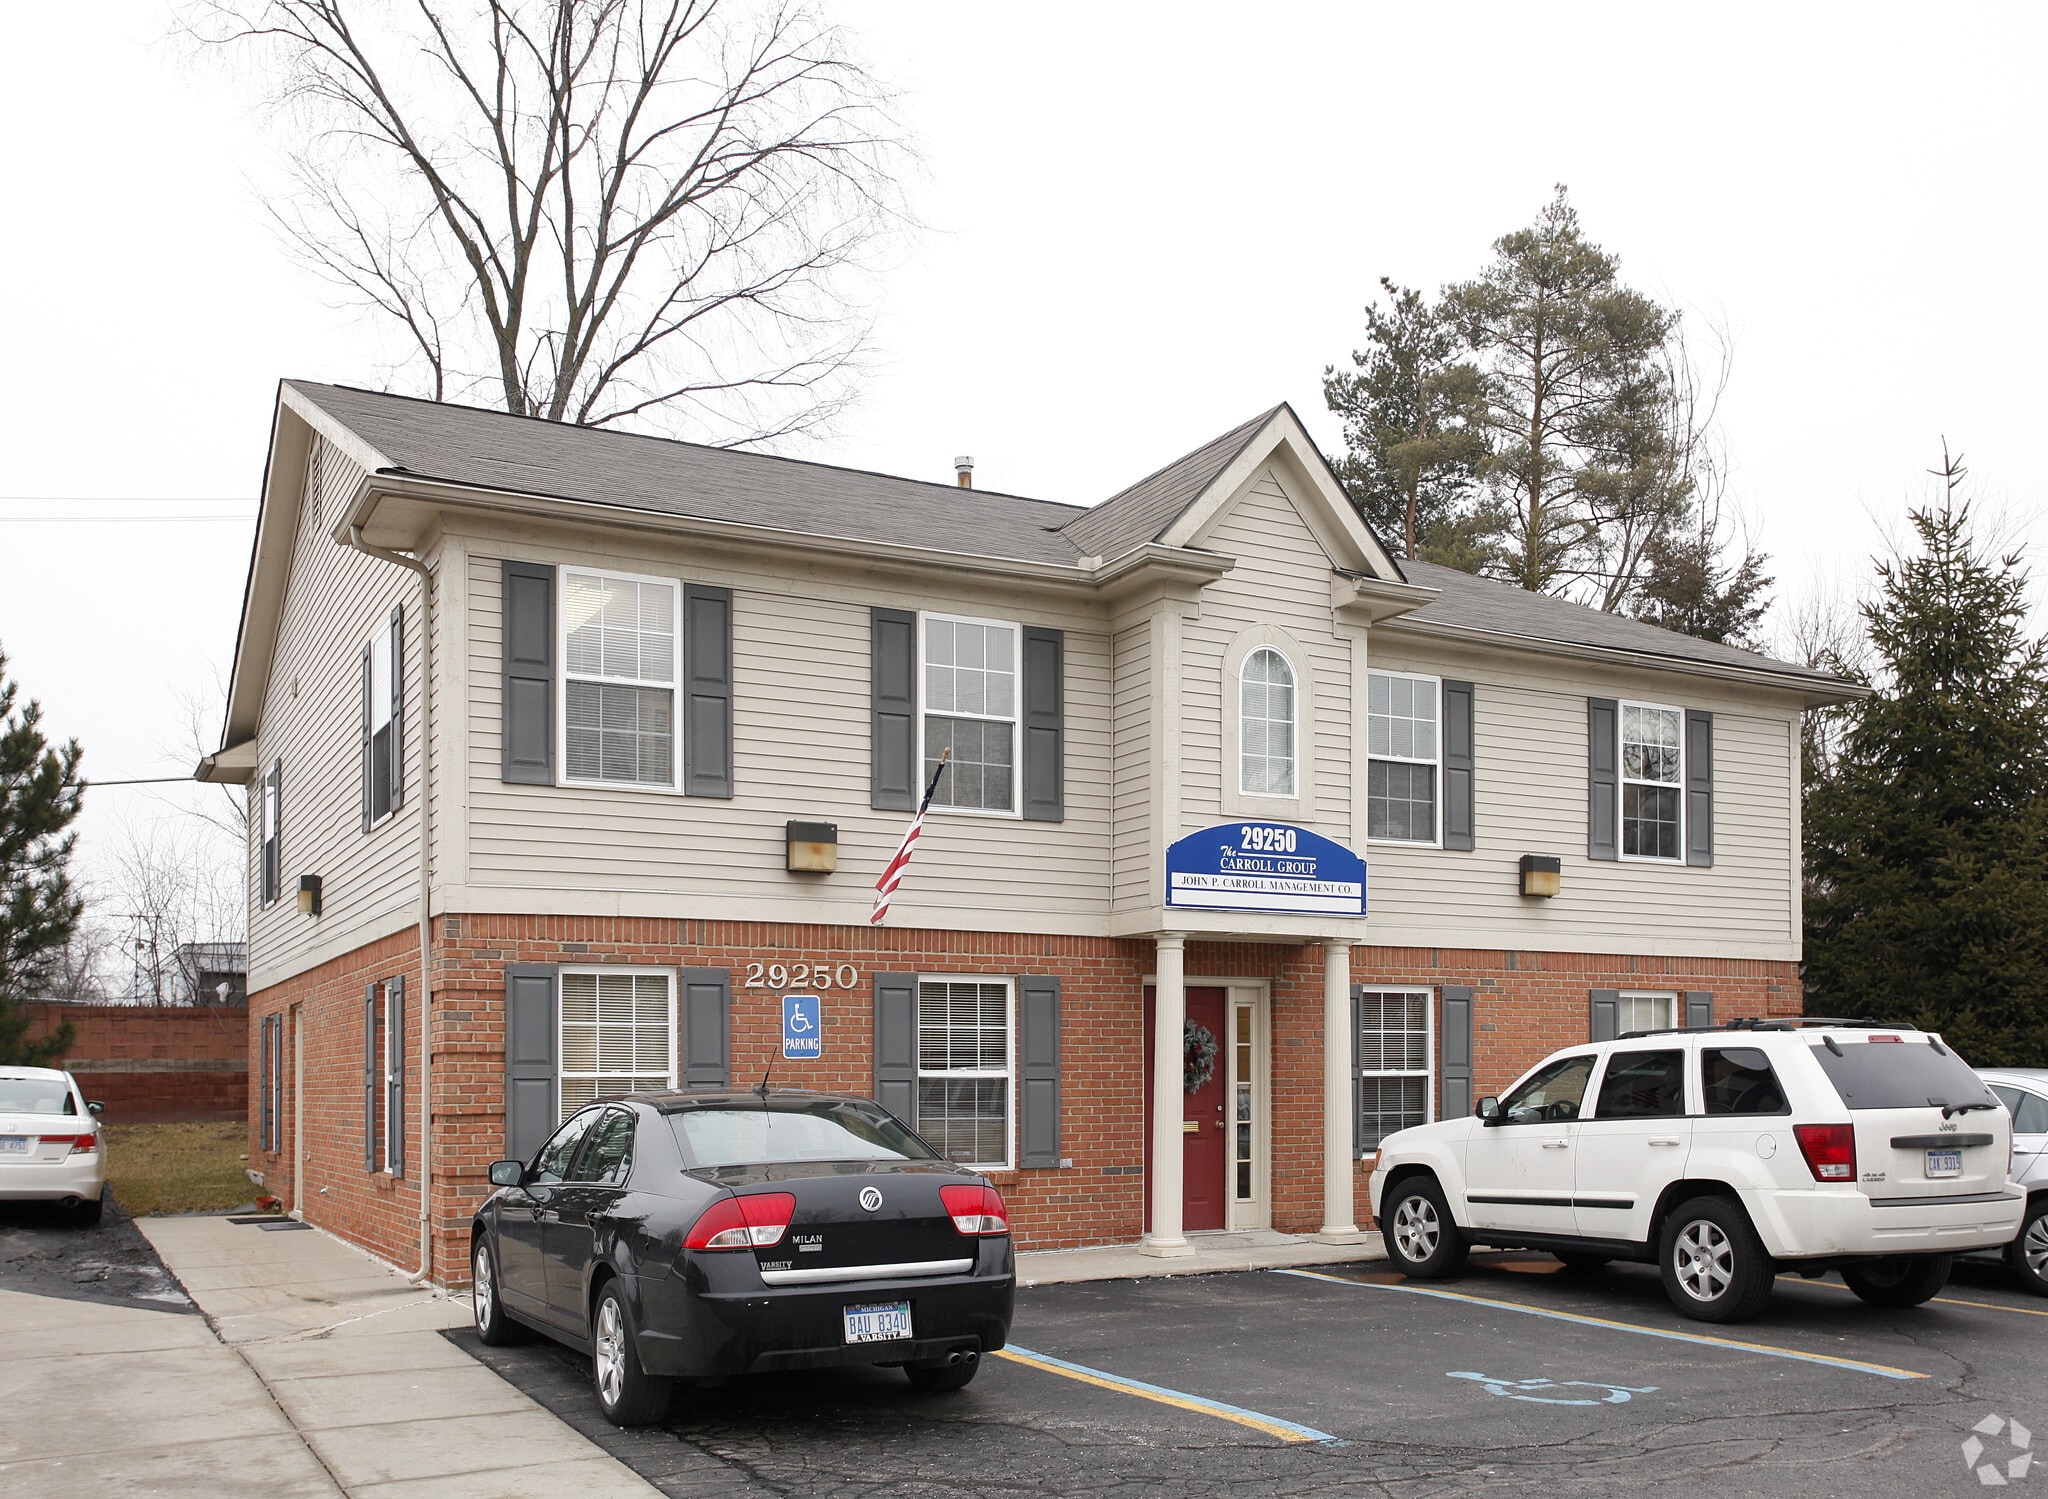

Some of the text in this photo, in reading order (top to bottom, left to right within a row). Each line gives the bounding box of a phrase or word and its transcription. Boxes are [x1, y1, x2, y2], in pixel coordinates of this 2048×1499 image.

[1241, 826, 1297, 852] 29250
[1220, 845, 1237, 857] The
[1220, 857, 1317, 874] CARROLL GROUP
[1181, 875, 1353, 894] JOHN P. CARROLL MANAGEMENT CO.
[745, 963, 858, 989] 29250
[785, 1037, 819, 1050] PARKING
[1938, 1121, 1958, 1132] Jeep
[1944, 1156, 1961, 1170] 9319
[792, 1234, 823, 1244] MILAN
[760, 1260, 793, 1271] VARSITY
[860, 1305, 893, 1313] MICHIGAN
[849, 1312, 907, 1335] BAU 8340
[860, 1331, 898, 1342] VARSITY
